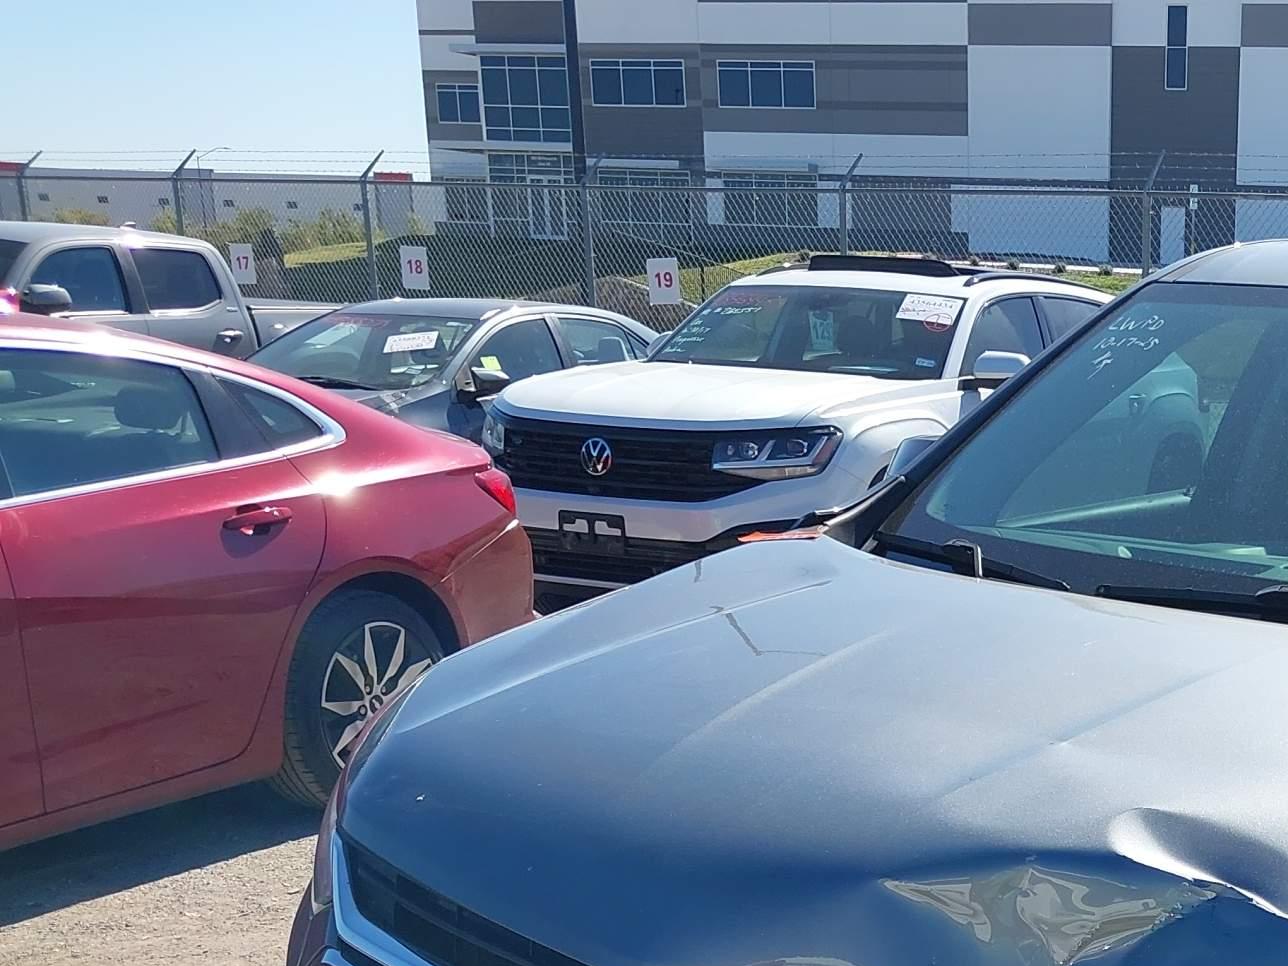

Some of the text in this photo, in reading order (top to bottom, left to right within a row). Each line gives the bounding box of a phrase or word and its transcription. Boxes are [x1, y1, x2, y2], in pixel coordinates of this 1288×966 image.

[235, 256, 249, 270] 17
[406, 259, 423, 274] 18
[655, 271, 673, 289] 19
